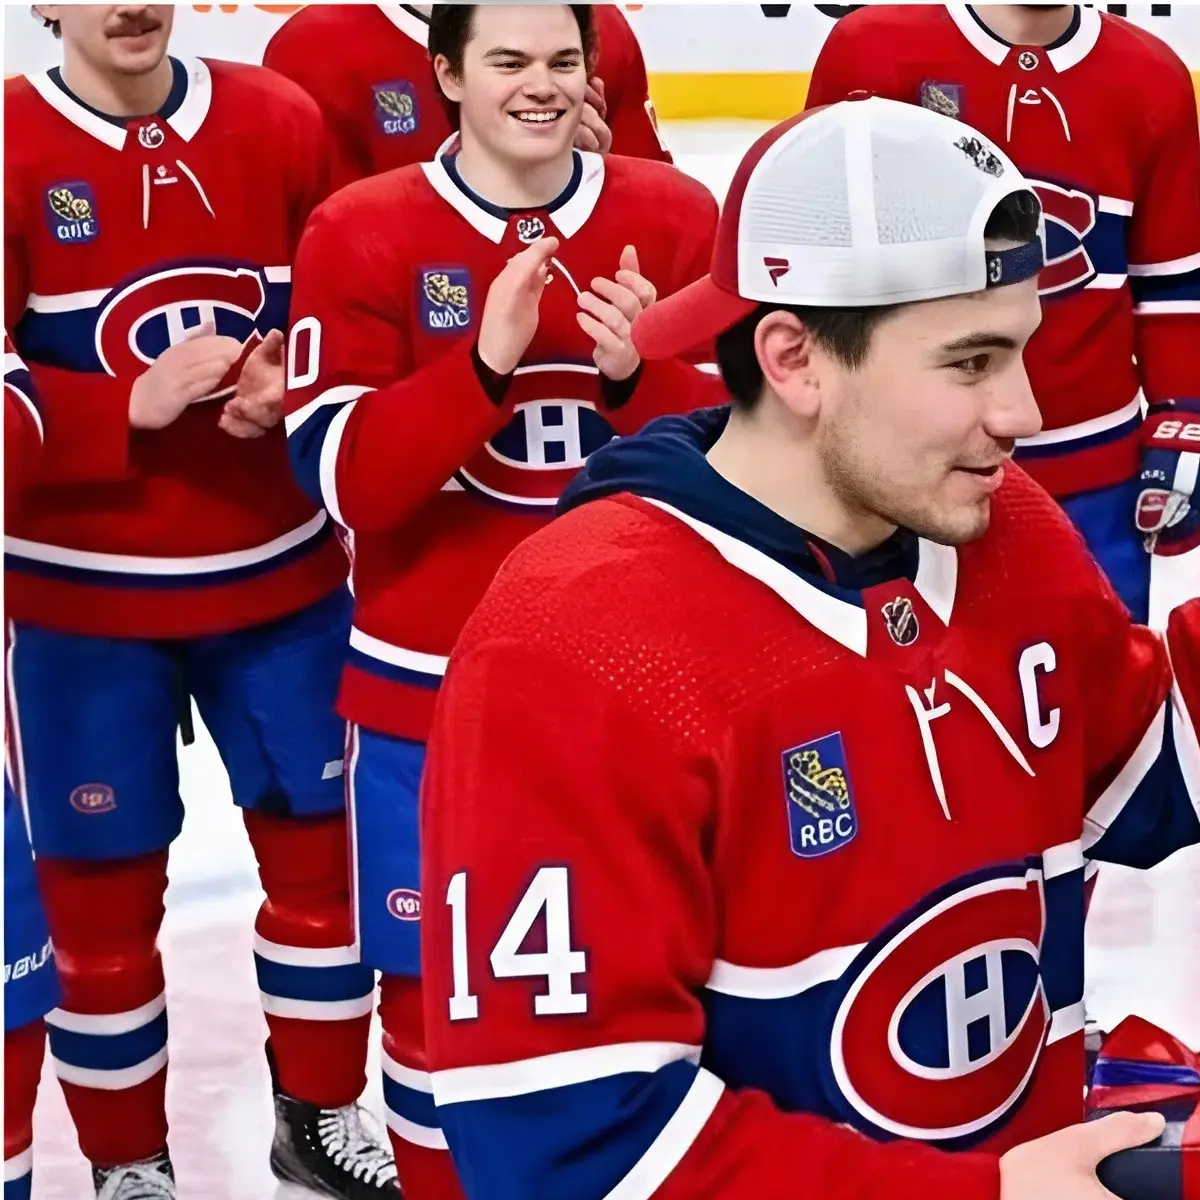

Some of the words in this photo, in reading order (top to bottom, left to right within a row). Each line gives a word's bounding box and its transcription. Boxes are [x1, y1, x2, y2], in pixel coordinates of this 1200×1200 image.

[1019, 641, 1060, 748] C
[800, 813, 852, 848] RBC
[446, 867, 588, 1020] 14
